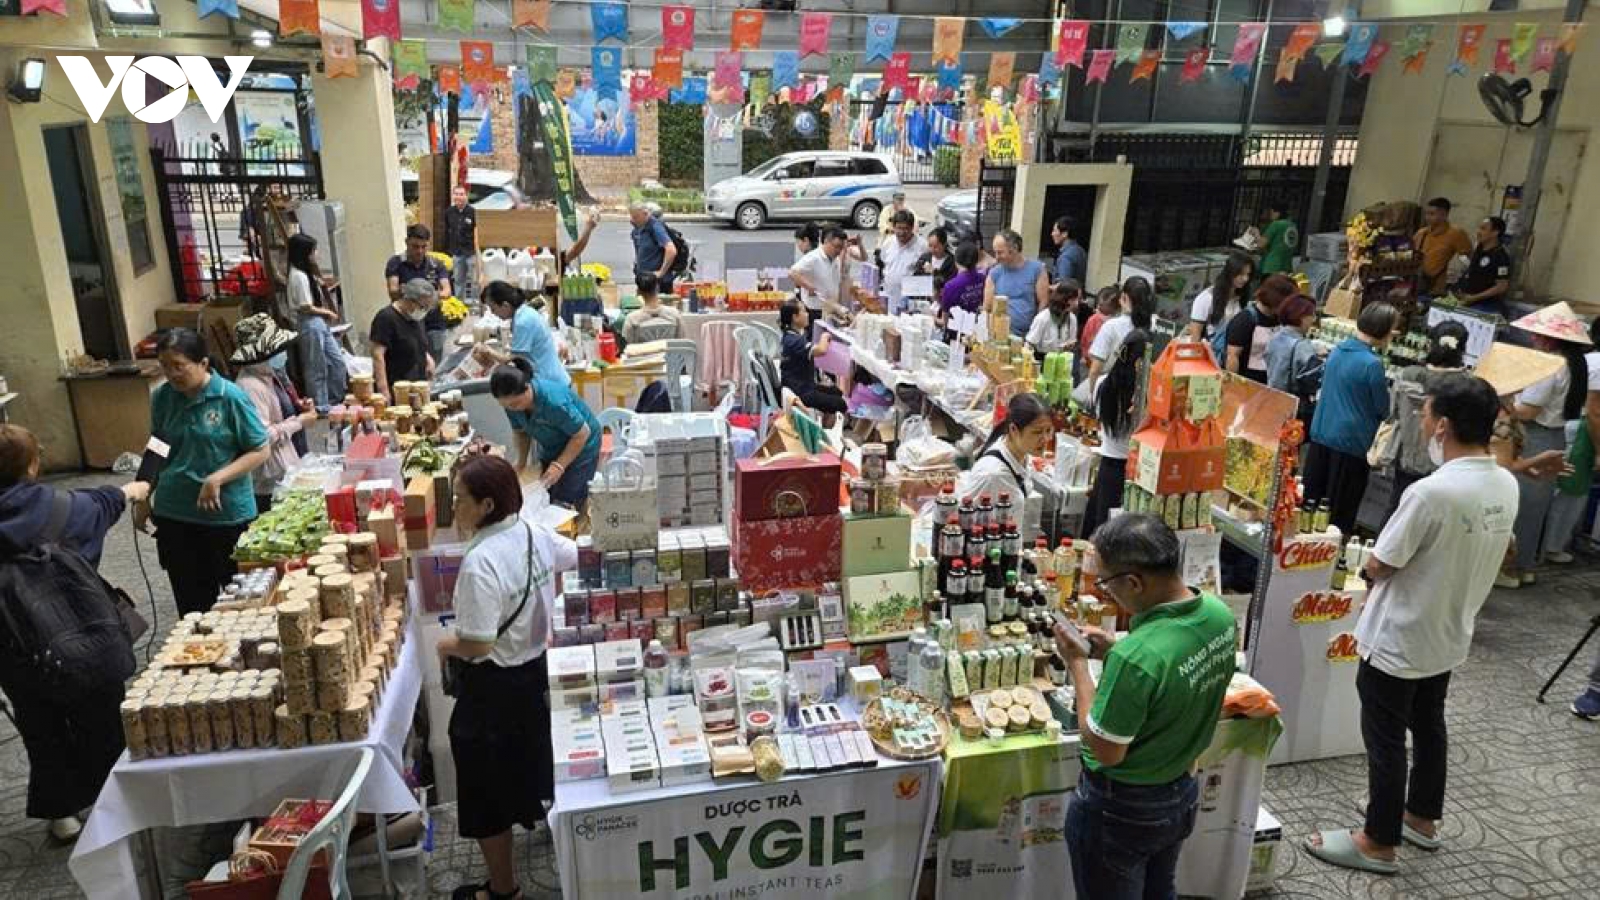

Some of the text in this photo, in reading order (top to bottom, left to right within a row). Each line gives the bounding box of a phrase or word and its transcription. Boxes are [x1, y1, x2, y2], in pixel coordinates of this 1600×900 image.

[705, 799, 761, 819] DƯỢC
[638, 810, 866, 893] HYGIE
[730, 876, 795, 899] INSTANT
[806, 874, 843, 890] TEAS
